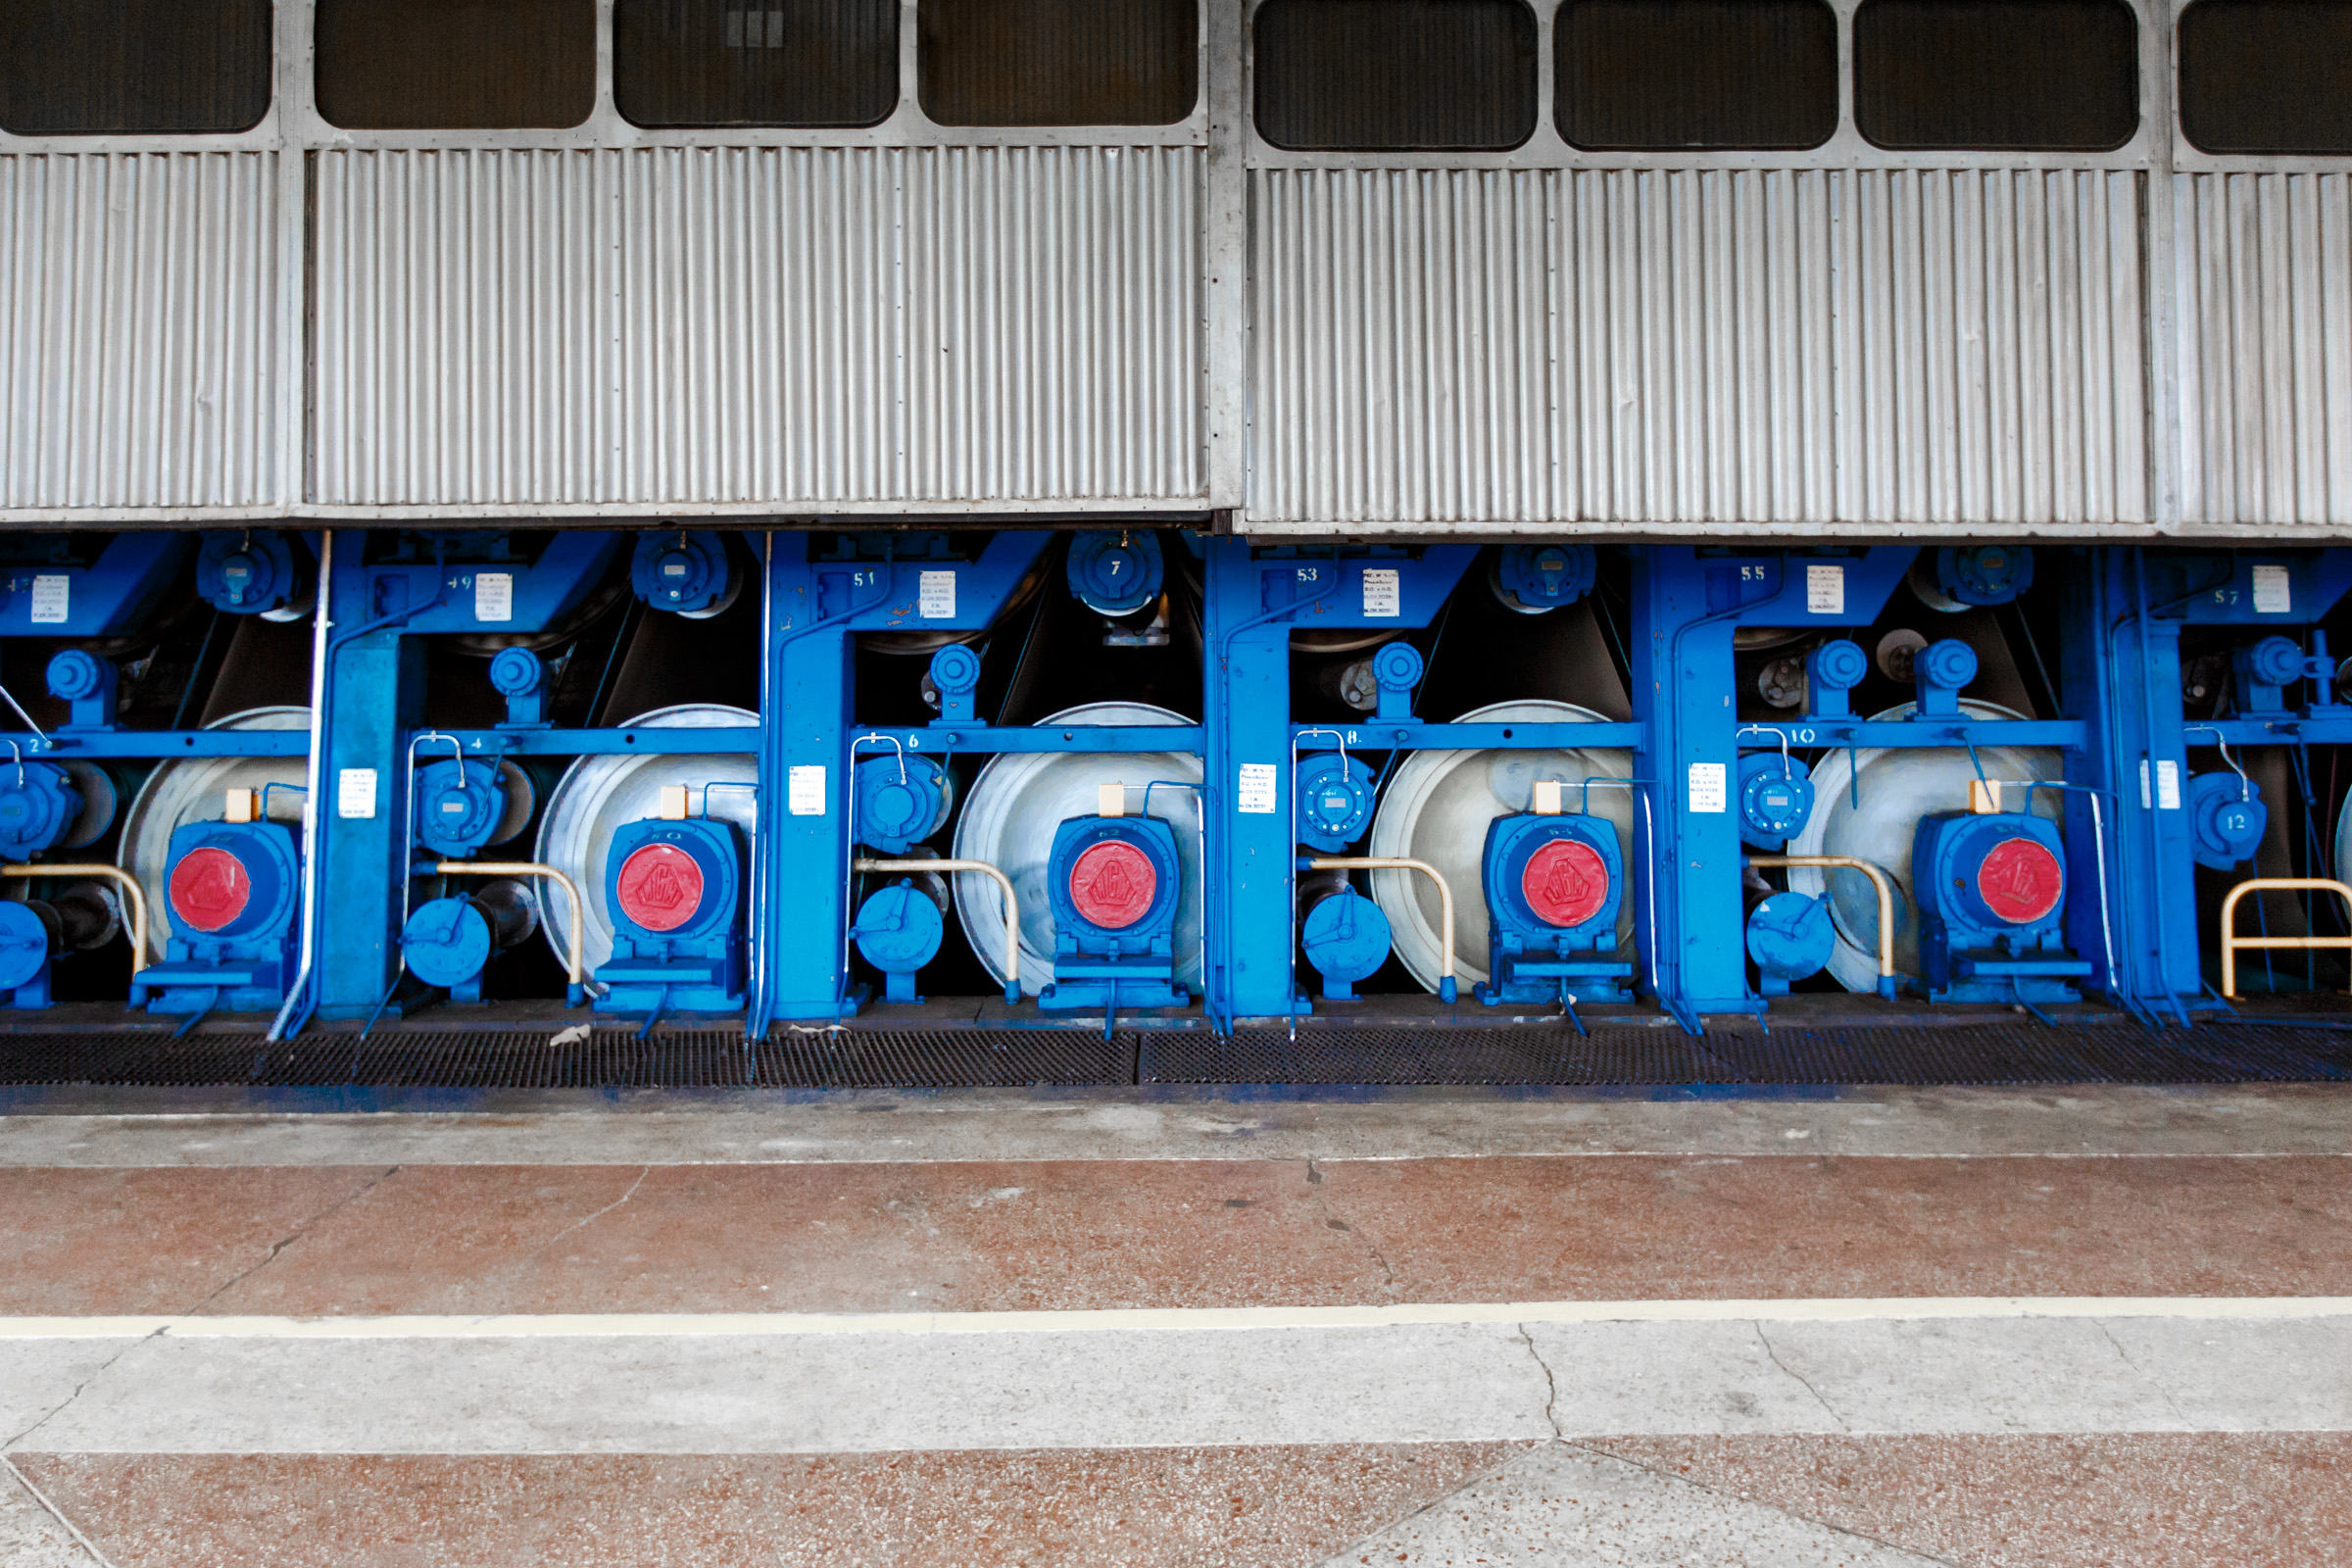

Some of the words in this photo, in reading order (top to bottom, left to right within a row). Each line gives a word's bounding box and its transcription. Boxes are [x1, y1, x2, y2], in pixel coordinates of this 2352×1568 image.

[1110, 561, 1120, 576] 7
[1298, 567, 1318, 582] 53
[1740, 565, 1765, 581] 55
[448, 575, 471, 590] 49
[855, 571, 874, 587] 51
[2215, 589, 2238, 606] 57
[471, 737, 482, 750] 4
[908, 734, 919, 749] 6
[1790, 728, 1816, 744] 10
[29, 738, 39, 753] 2
[2228, 814, 2245, 830] 12
